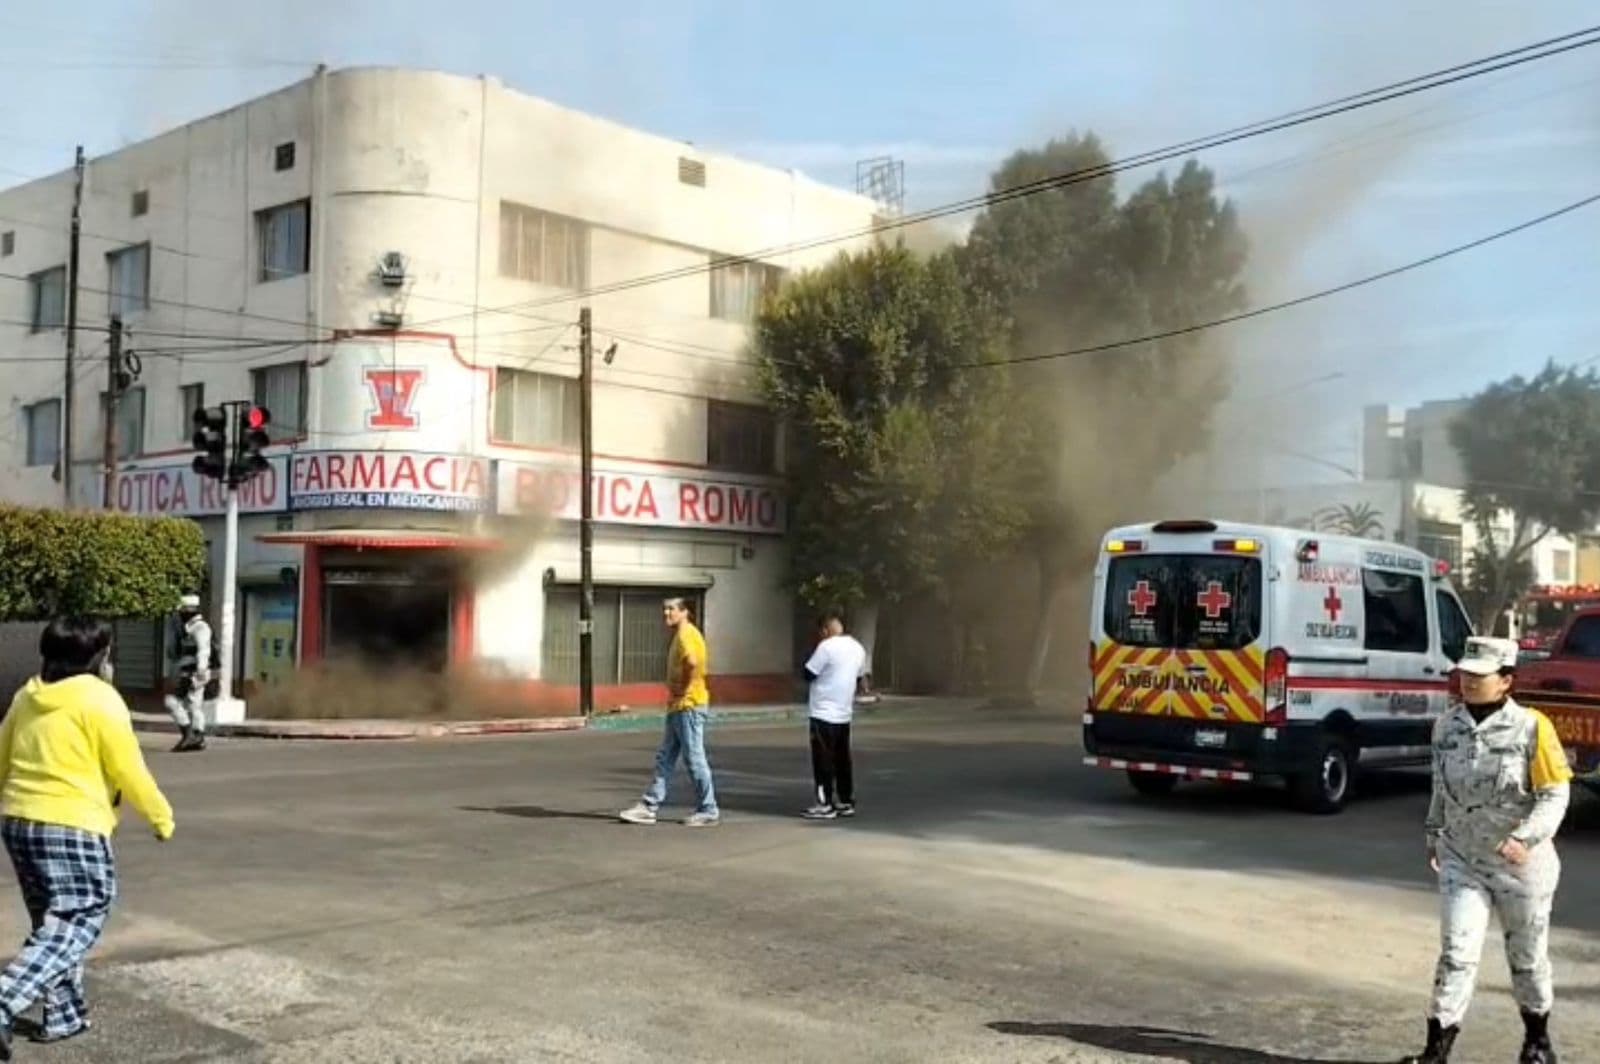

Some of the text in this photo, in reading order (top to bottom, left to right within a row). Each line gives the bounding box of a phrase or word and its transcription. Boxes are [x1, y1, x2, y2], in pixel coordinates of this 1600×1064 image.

[108, 470, 189, 513] OTICA
[293, 453, 486, 493] FARMACIA
[367, 493, 385, 506] EN
[679, 482, 777, 529] ROMO
